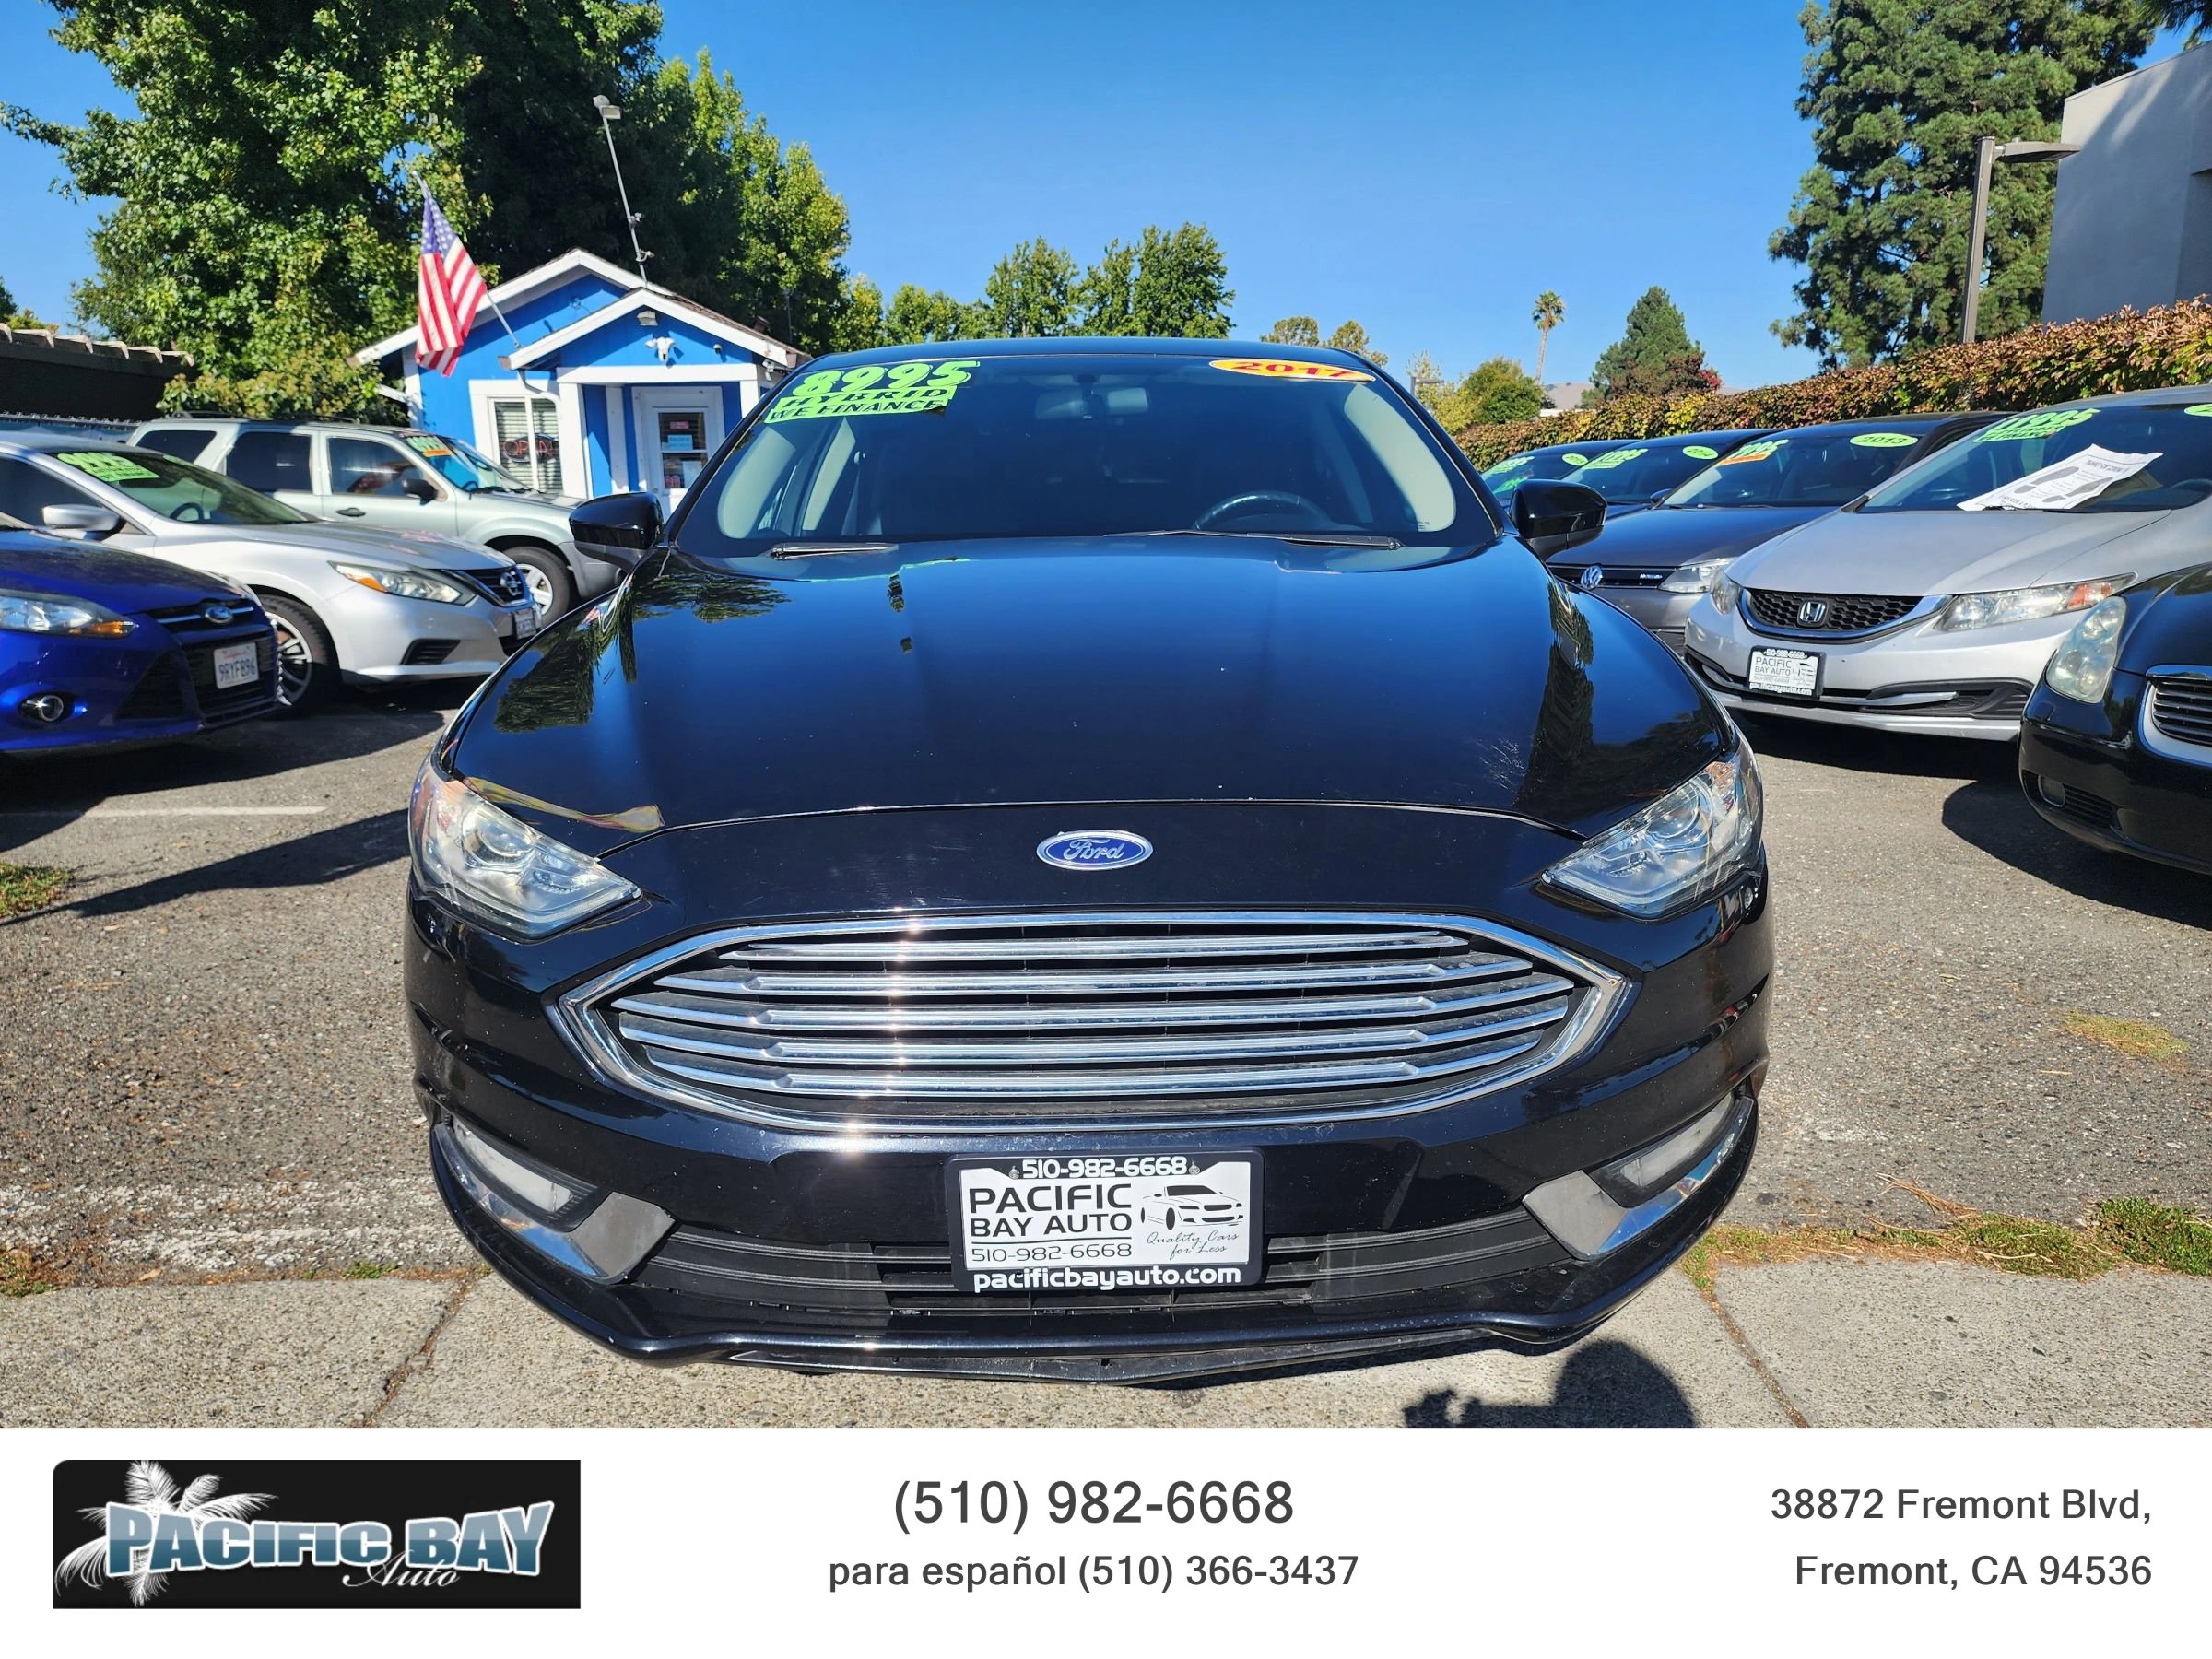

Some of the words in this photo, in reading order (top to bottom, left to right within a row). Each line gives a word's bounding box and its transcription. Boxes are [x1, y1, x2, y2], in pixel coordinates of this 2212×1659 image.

[793, 360, 980, 396] 8995
[1231, 361, 1355, 377] 2017
[784, 388, 948, 407] HYBRID
[771, 407, 809, 420] WE
[818, 399, 944, 414] FINANCE
[501, 439, 554, 457] OPN
[1857, 436, 1908, 444] 2013
[1756, 657, 1792, 668] PACIFIC
[1063, 838, 1125, 860] Ford
[1022, 1156, 1188, 1179] 510-982-6668
[969, 1183, 1132, 1214] PACIFIC
[971, 1217, 1033, 1238] BAY
[1043, 1213, 1132, 1235] AUTO
[1147, 1231, 1200, 1245] Quality
[1208, 1230, 1240, 1242] Cars
[971, 1243, 1132, 1262] 510-982-6668
[1169, 1245, 1191, 1261] for
[1194, 1241, 1228, 1254] Less
[974, 1264, 1241, 1292] pacificbayauto.com
